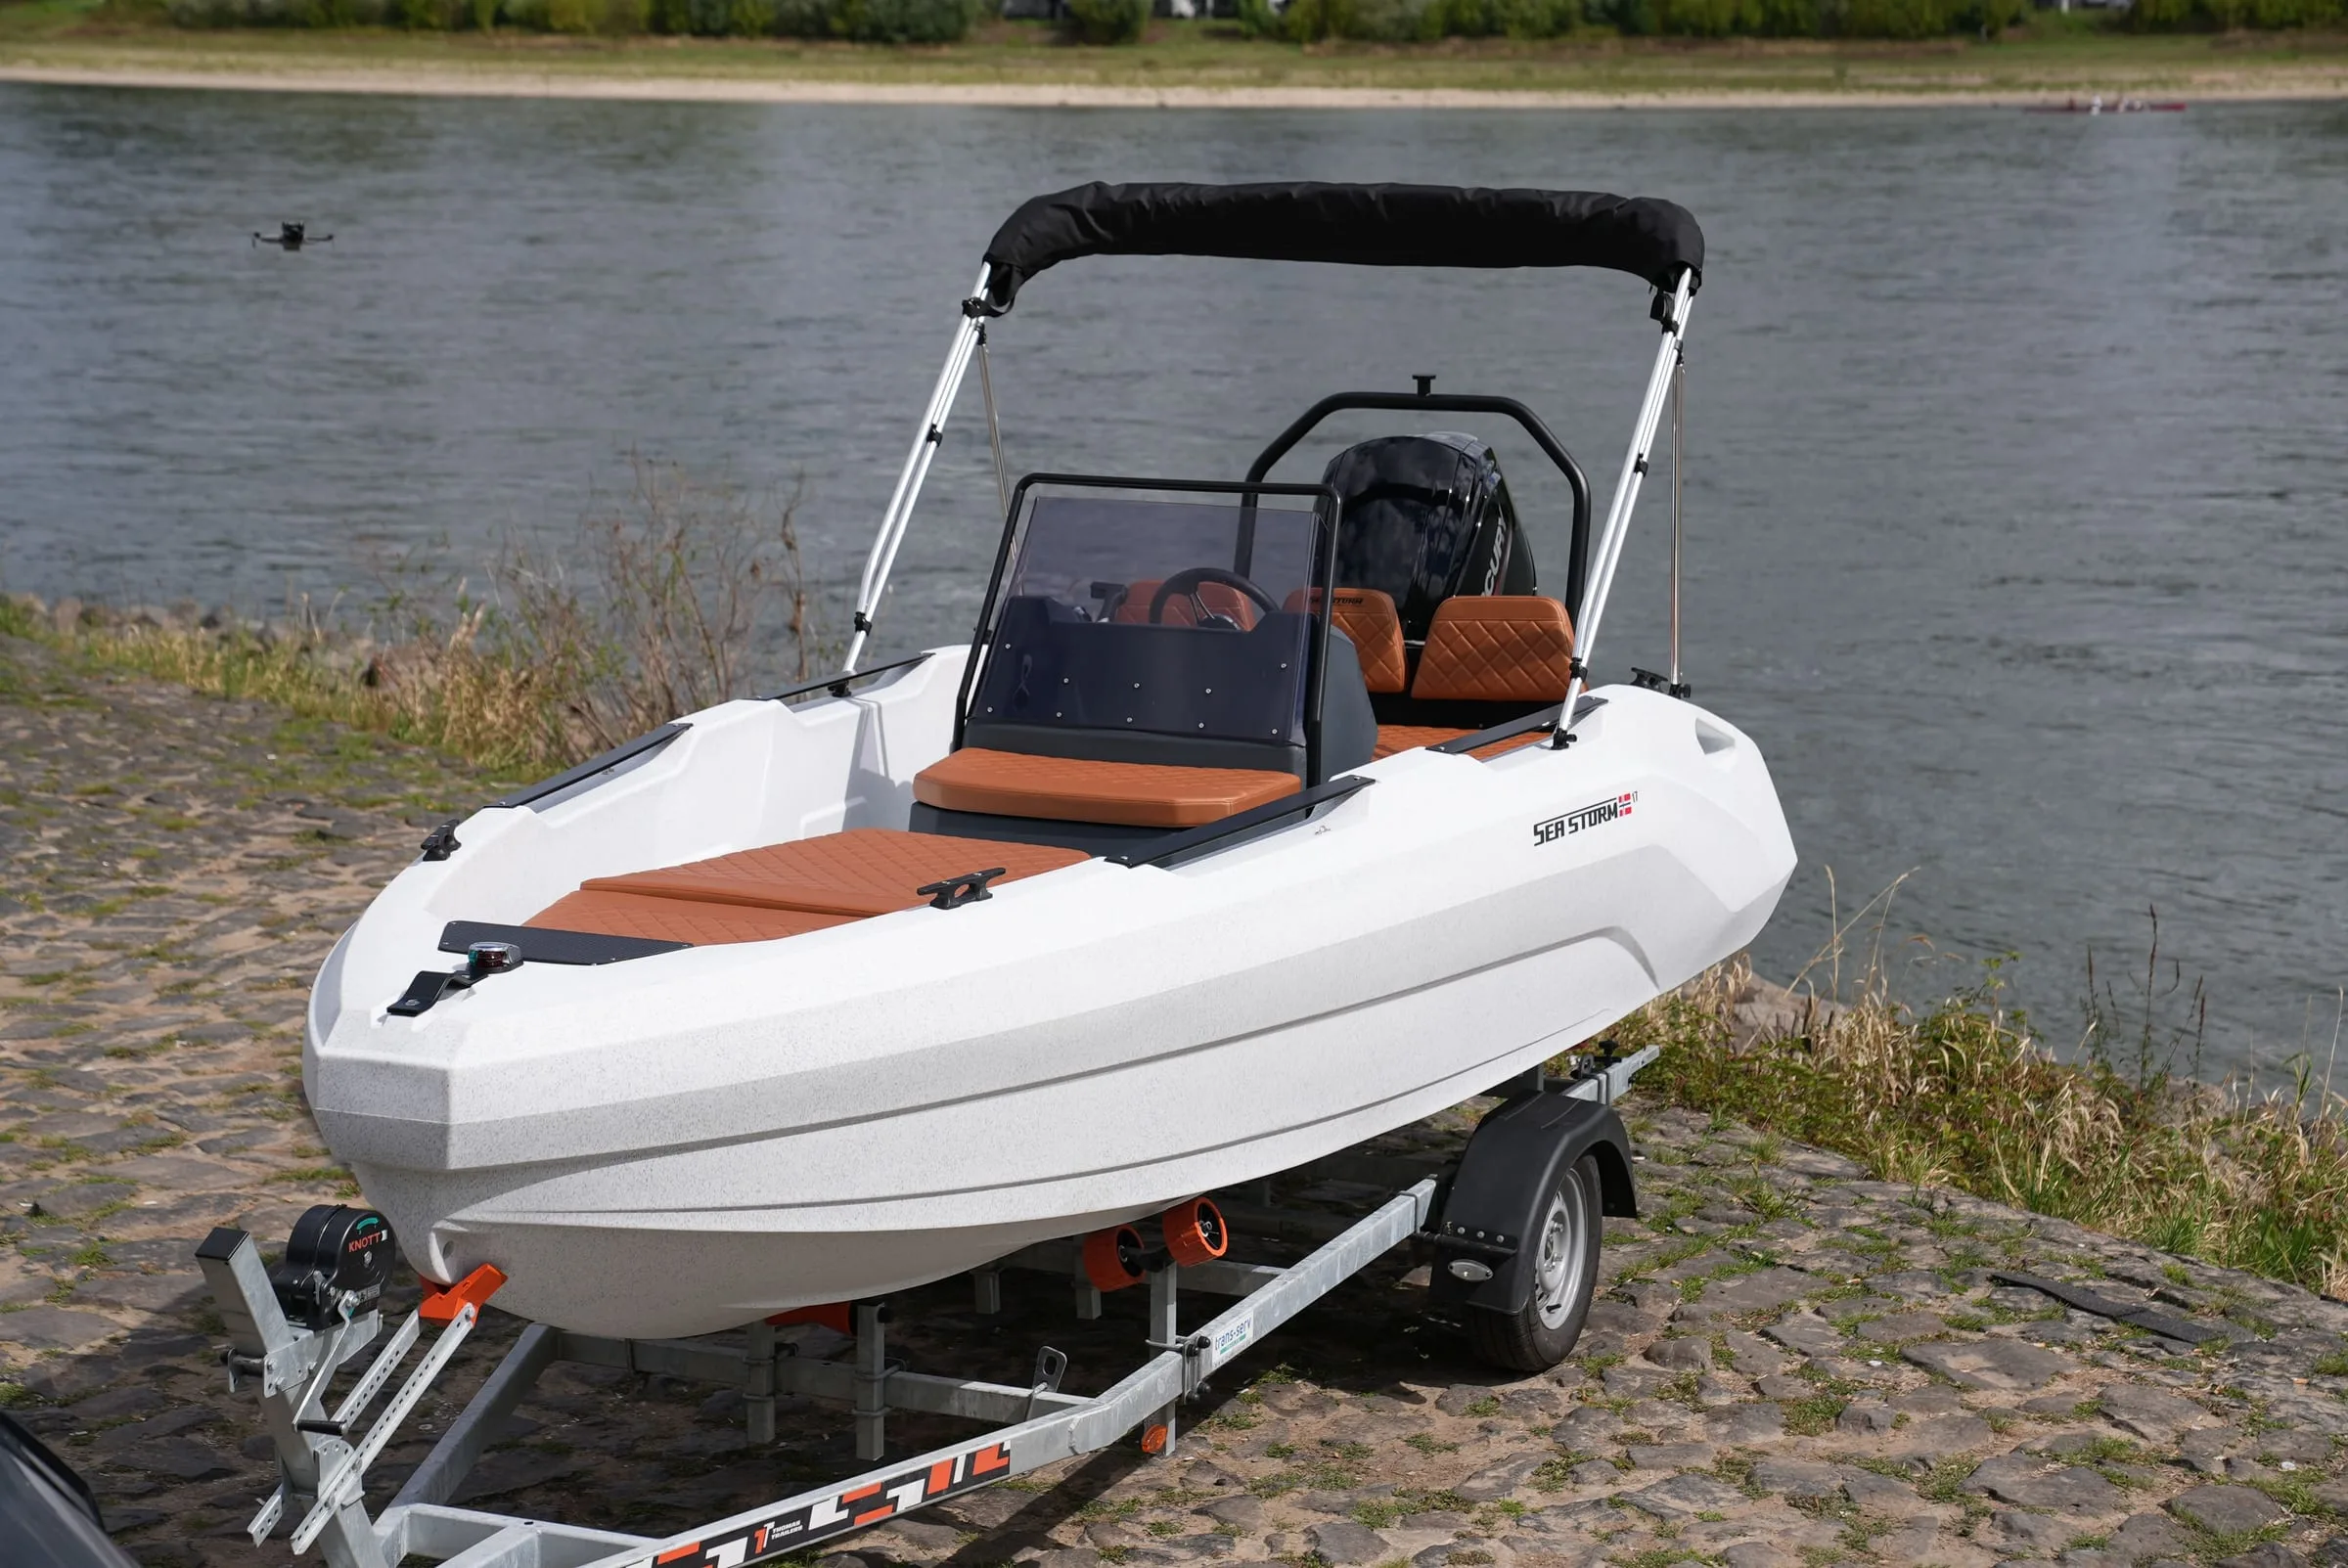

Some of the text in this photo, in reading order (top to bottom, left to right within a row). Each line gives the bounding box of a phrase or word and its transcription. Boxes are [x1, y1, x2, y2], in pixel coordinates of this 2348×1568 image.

[1480, 504, 1507, 598] CURY
[1533, 820, 1565, 847] SEA
[1568, 801, 1618, 834] STORM
[348, 1232, 381, 1253] KNOTT
